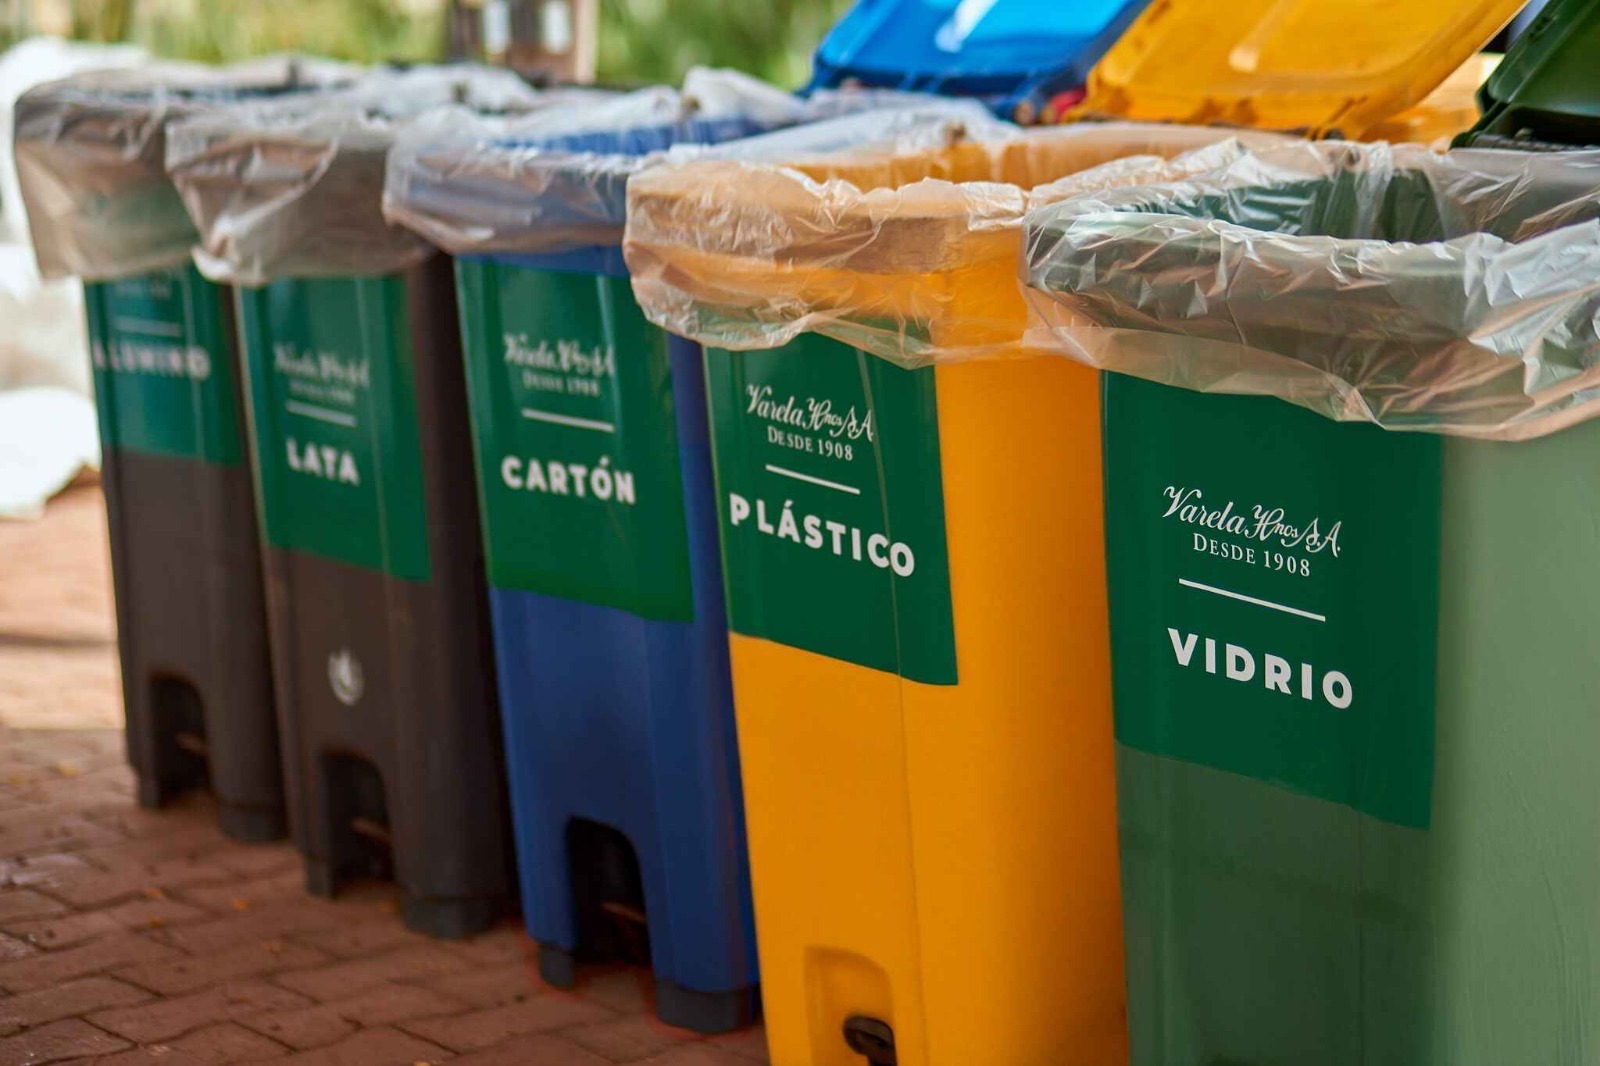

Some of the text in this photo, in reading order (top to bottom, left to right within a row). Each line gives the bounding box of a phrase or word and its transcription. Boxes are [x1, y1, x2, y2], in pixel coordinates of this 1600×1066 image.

[746, 384, 803, 428] Varela
[285, 437, 361, 487] LATA
[767, 424, 854, 461] DESDE 1908
[501, 454, 636, 505] CARTÓN
[729, 493, 915, 577] PLÁSTICO
[1162, 485, 1247, 535] Varela
[1193, 532, 1310, 577] DESDE 1908
[1167, 627, 1352, 709] VIDRIO
